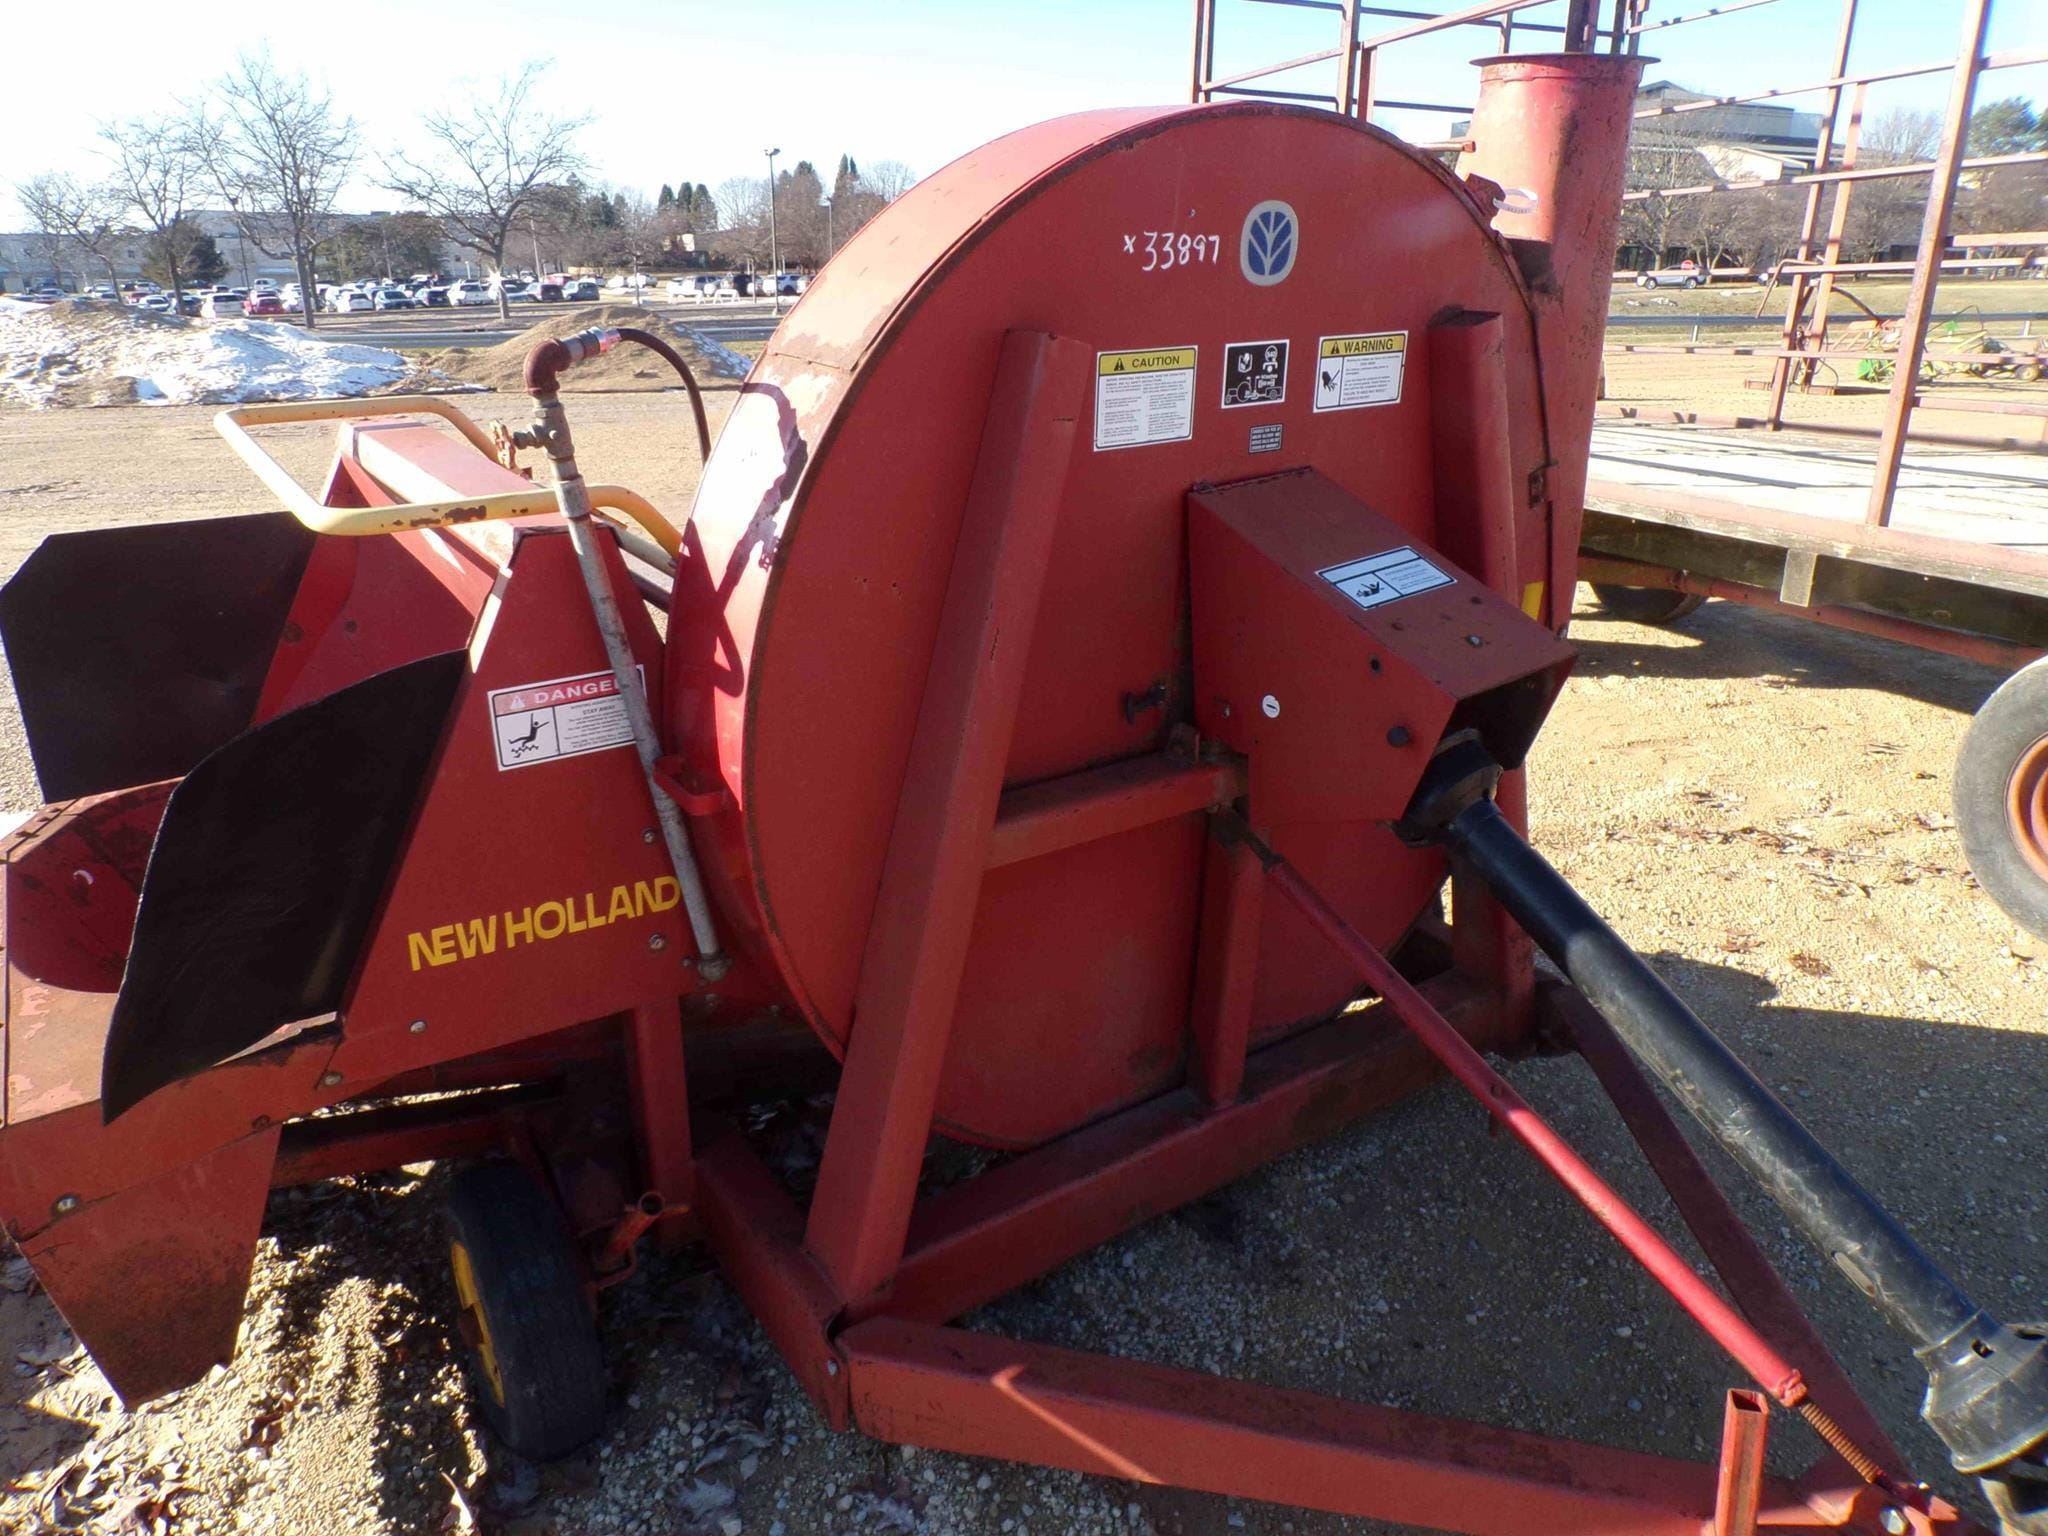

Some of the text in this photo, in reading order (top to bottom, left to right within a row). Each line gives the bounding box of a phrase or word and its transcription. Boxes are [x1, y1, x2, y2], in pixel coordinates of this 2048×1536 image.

[1344, 339, 1393, 353] WARNING
[1132, 356, 1180, 368] CAUTION
[534, 679, 620, 704] DANGE
[408, 875, 682, 971] NEW HOLLAND
